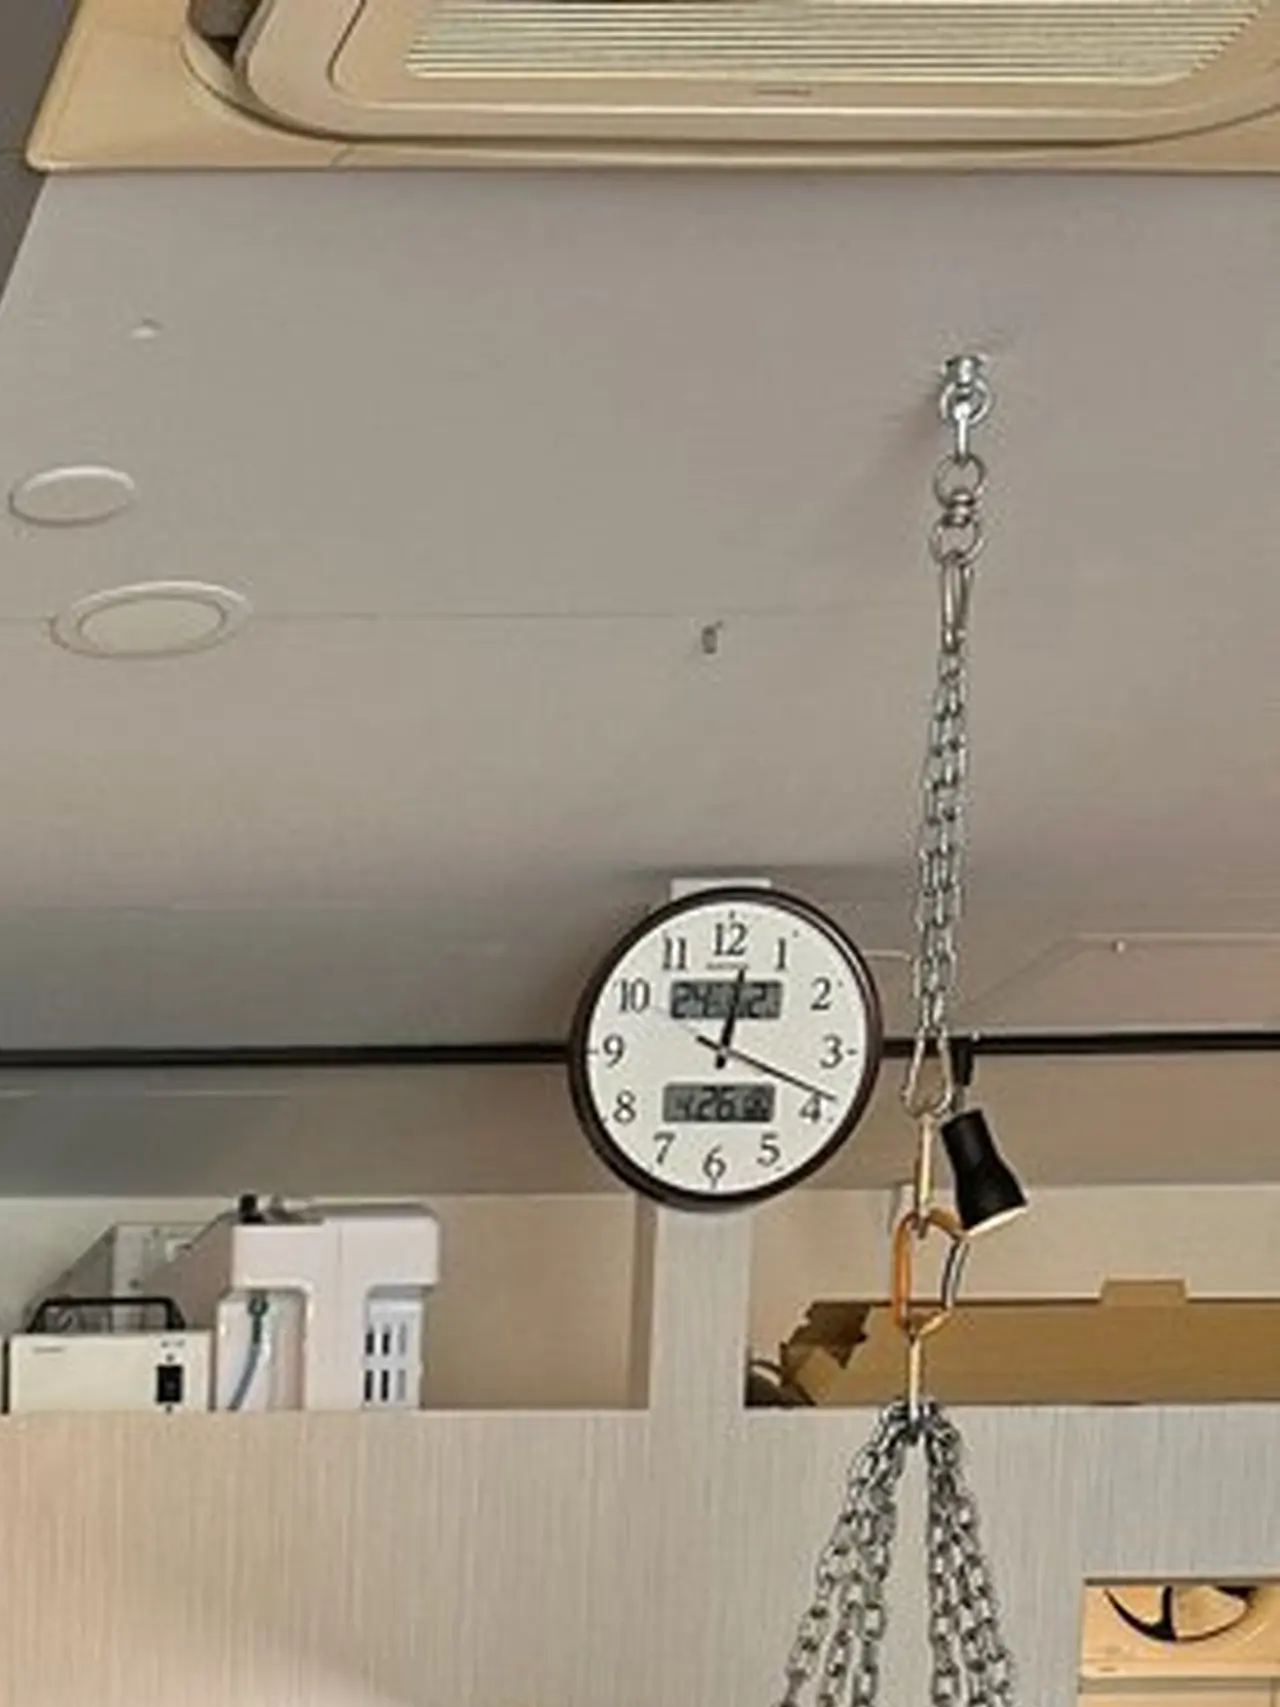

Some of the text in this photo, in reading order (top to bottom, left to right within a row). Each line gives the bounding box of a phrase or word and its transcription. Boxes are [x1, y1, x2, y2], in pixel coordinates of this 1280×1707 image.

[661, 936, 688, 971] 11
[713, 922, 747, 957] 12
[774, 936, 788, 971] 1
[617, 977, 651, 1013] 10
[810, 977, 833, 1011] 2
[602, 1034, 625, 1068] 9
[819, 1034, 844, 1069] 3
[612, 1090, 637, 1124] 8
[798, 1093, 823, 1124] 4
[653, 1132, 676, 1165] 7
[702, 1145, 727, 1182] 6
[757, 1133, 781, 1167] 5
